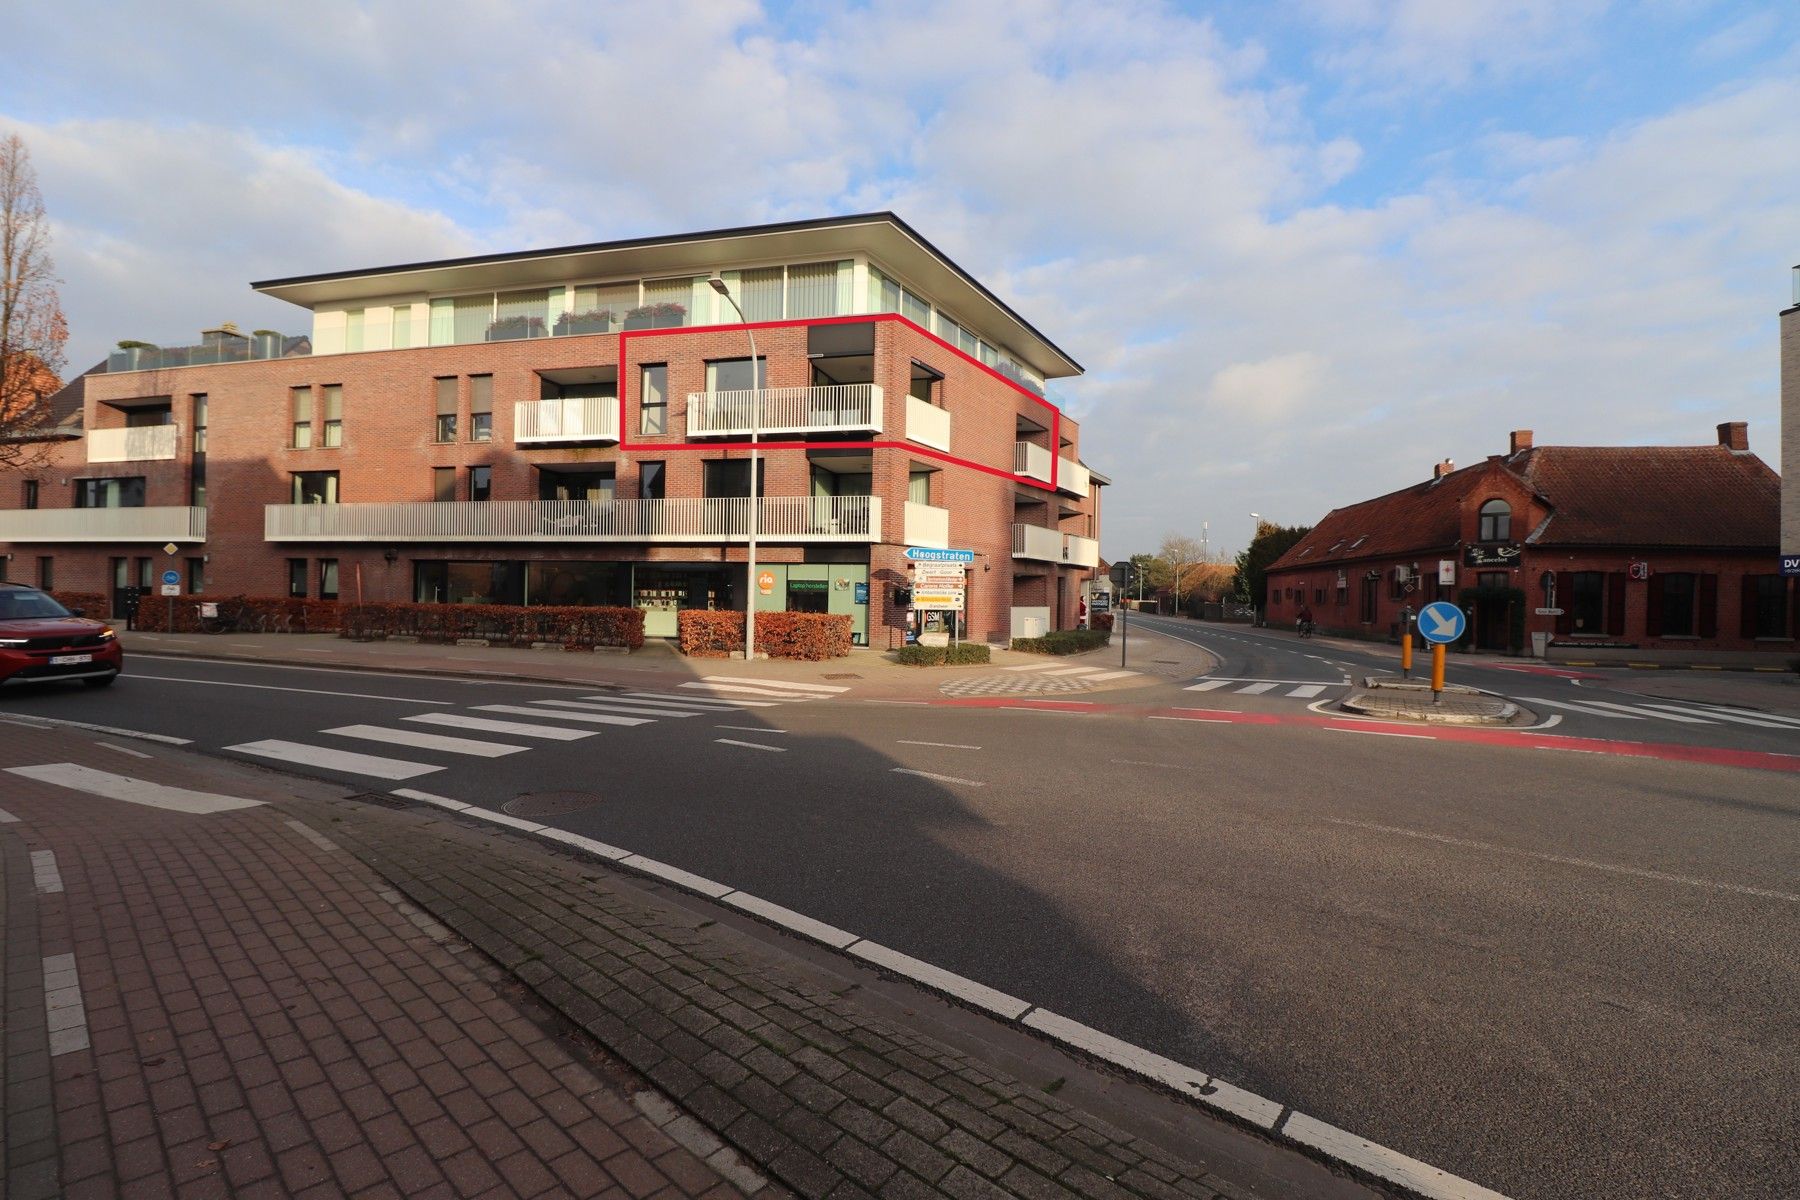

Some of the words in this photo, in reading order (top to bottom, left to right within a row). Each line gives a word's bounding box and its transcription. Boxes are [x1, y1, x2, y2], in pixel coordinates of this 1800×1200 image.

[912, 549, 970, 561] Hoogstraten
[1476, 555, 1508, 564] Lancelot
[1784, 559, 1800, 568] DV
[927, 611, 940, 622] GSM
